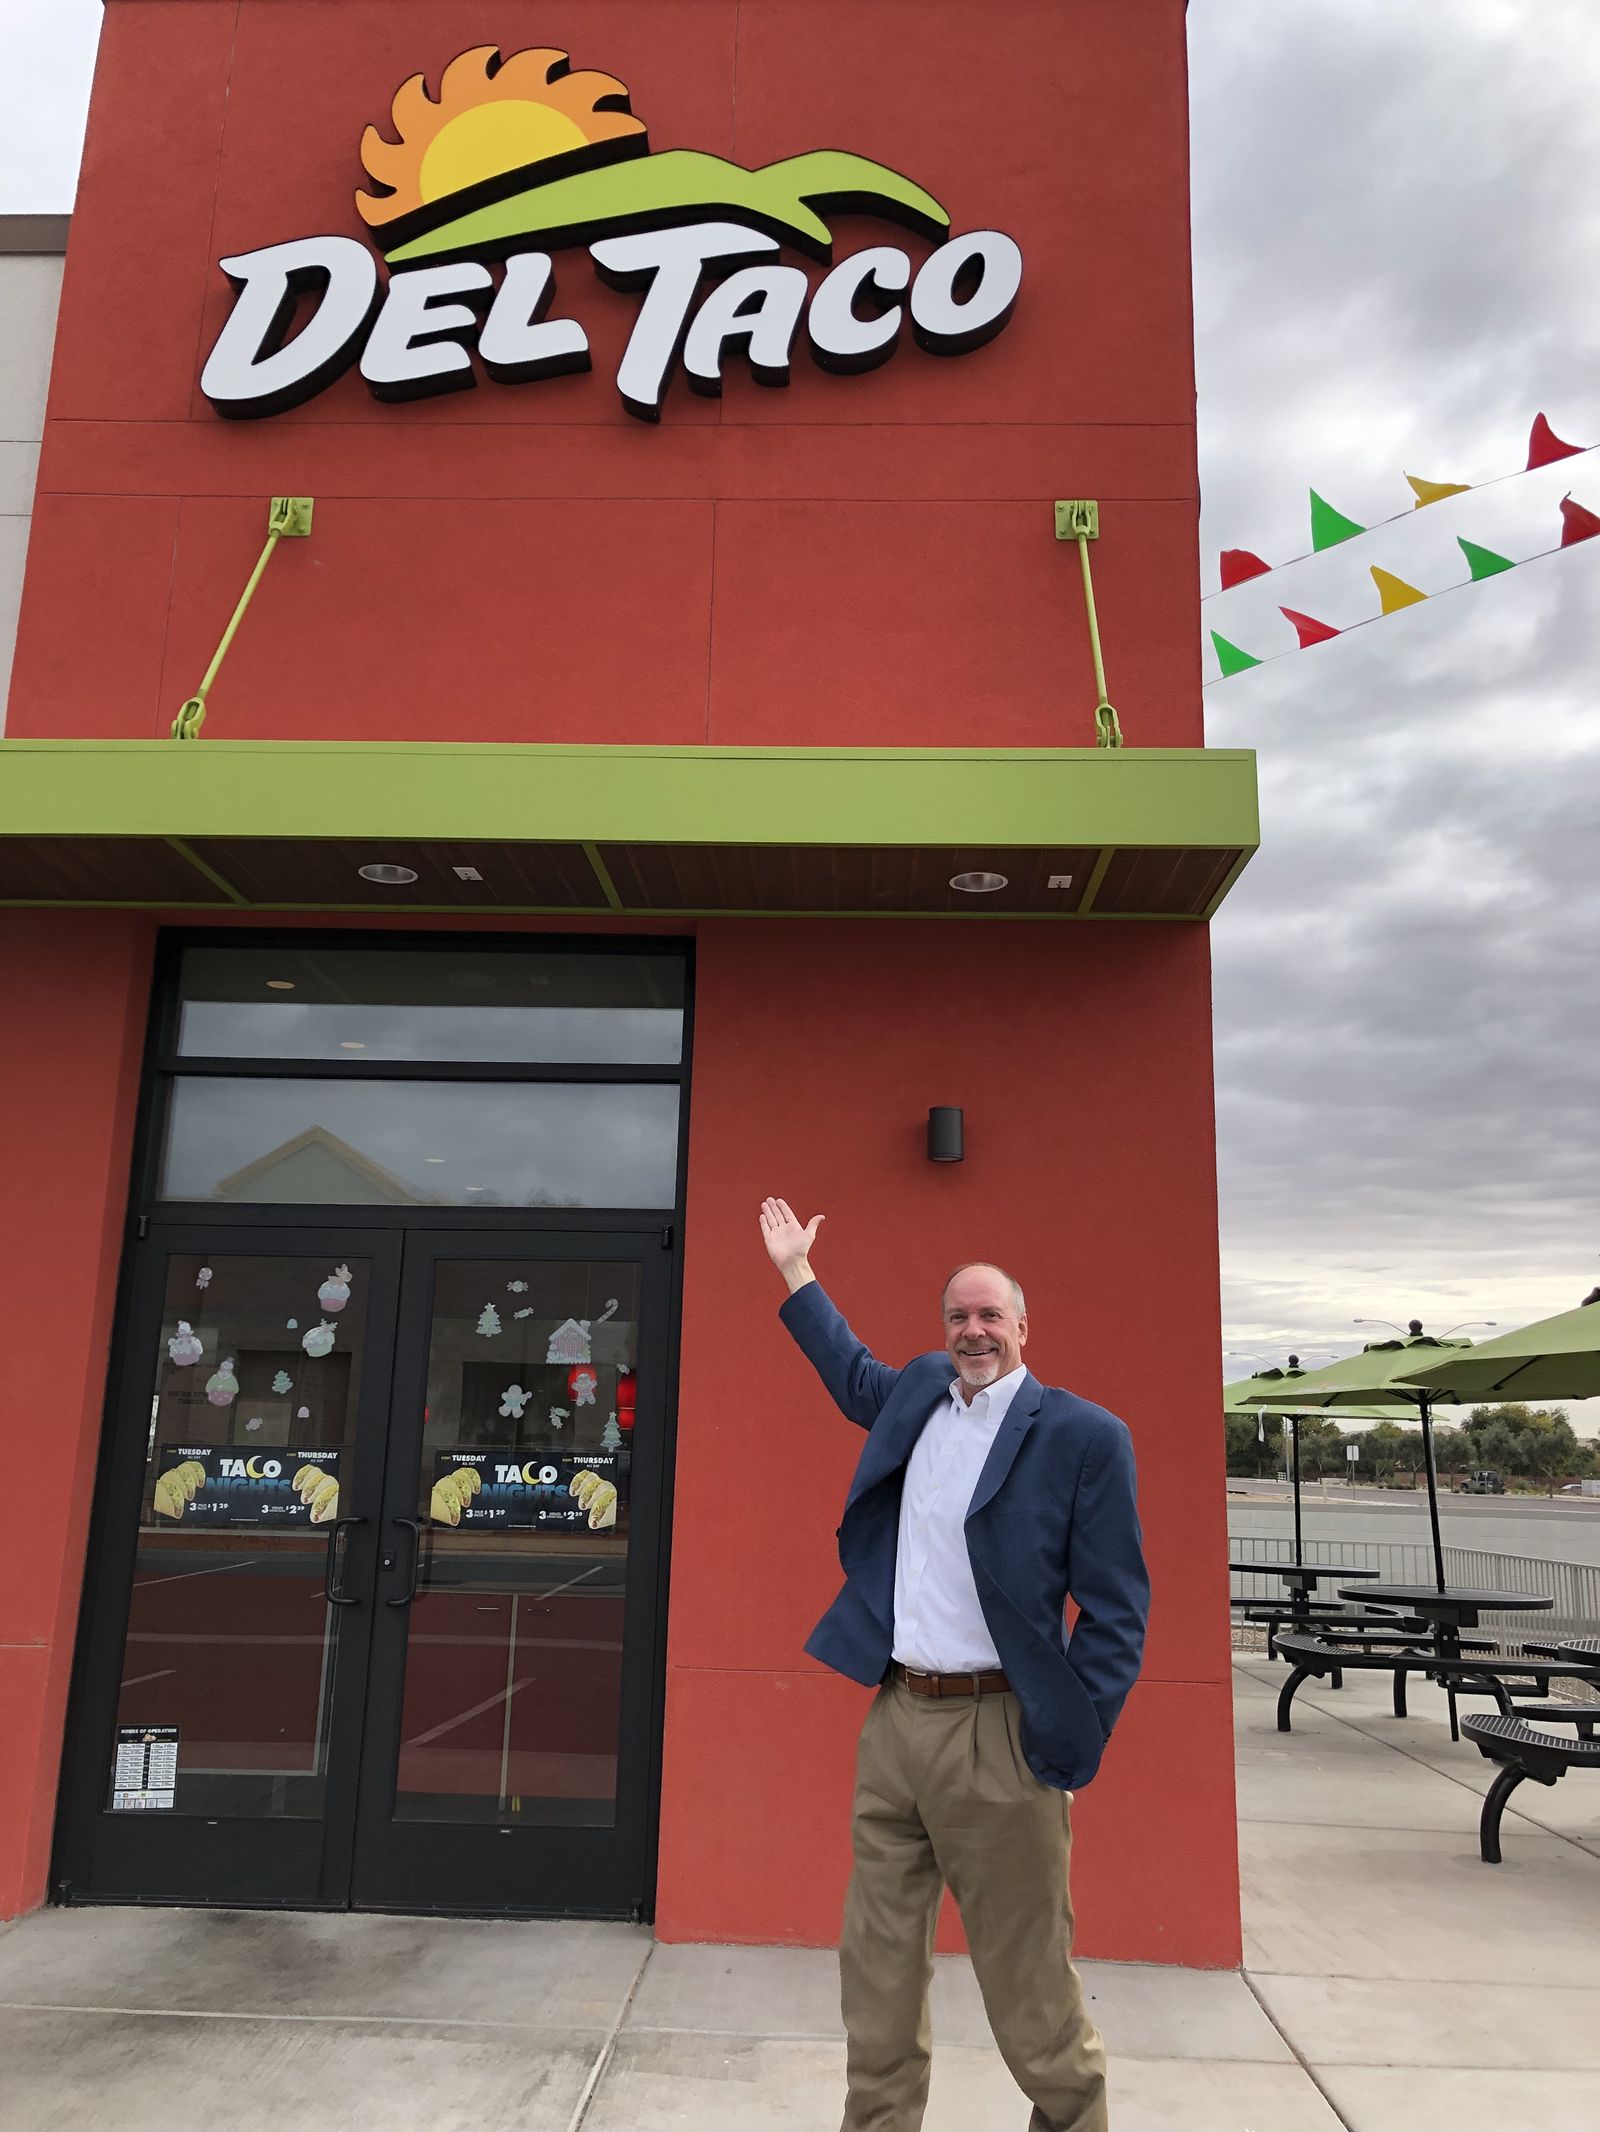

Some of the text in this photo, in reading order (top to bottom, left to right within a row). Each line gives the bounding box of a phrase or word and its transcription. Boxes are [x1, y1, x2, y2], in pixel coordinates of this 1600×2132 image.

[200, 221, 1023, 414] DEL TACO
[178, 1448, 212, 1456] TUESDAY
[297, 1451, 338, 1459] THURSDAY
[451, 1454, 487, 1462] TUESDAY
[573, 1456, 614, 1464] THURSDAY
[219, 1455, 282, 1479] TACO
[494, 1461, 558, 1485] TACO
[206, 1477, 291, 1496] NIGHTS
[481, 1483, 567, 1501] NIGHTS
[189, 1502, 197, 1511] 3
[261, 1504, 269, 1514] 3
[465, 1508, 474, 1518] 3
[538, 1510, 547, 1520] 3
